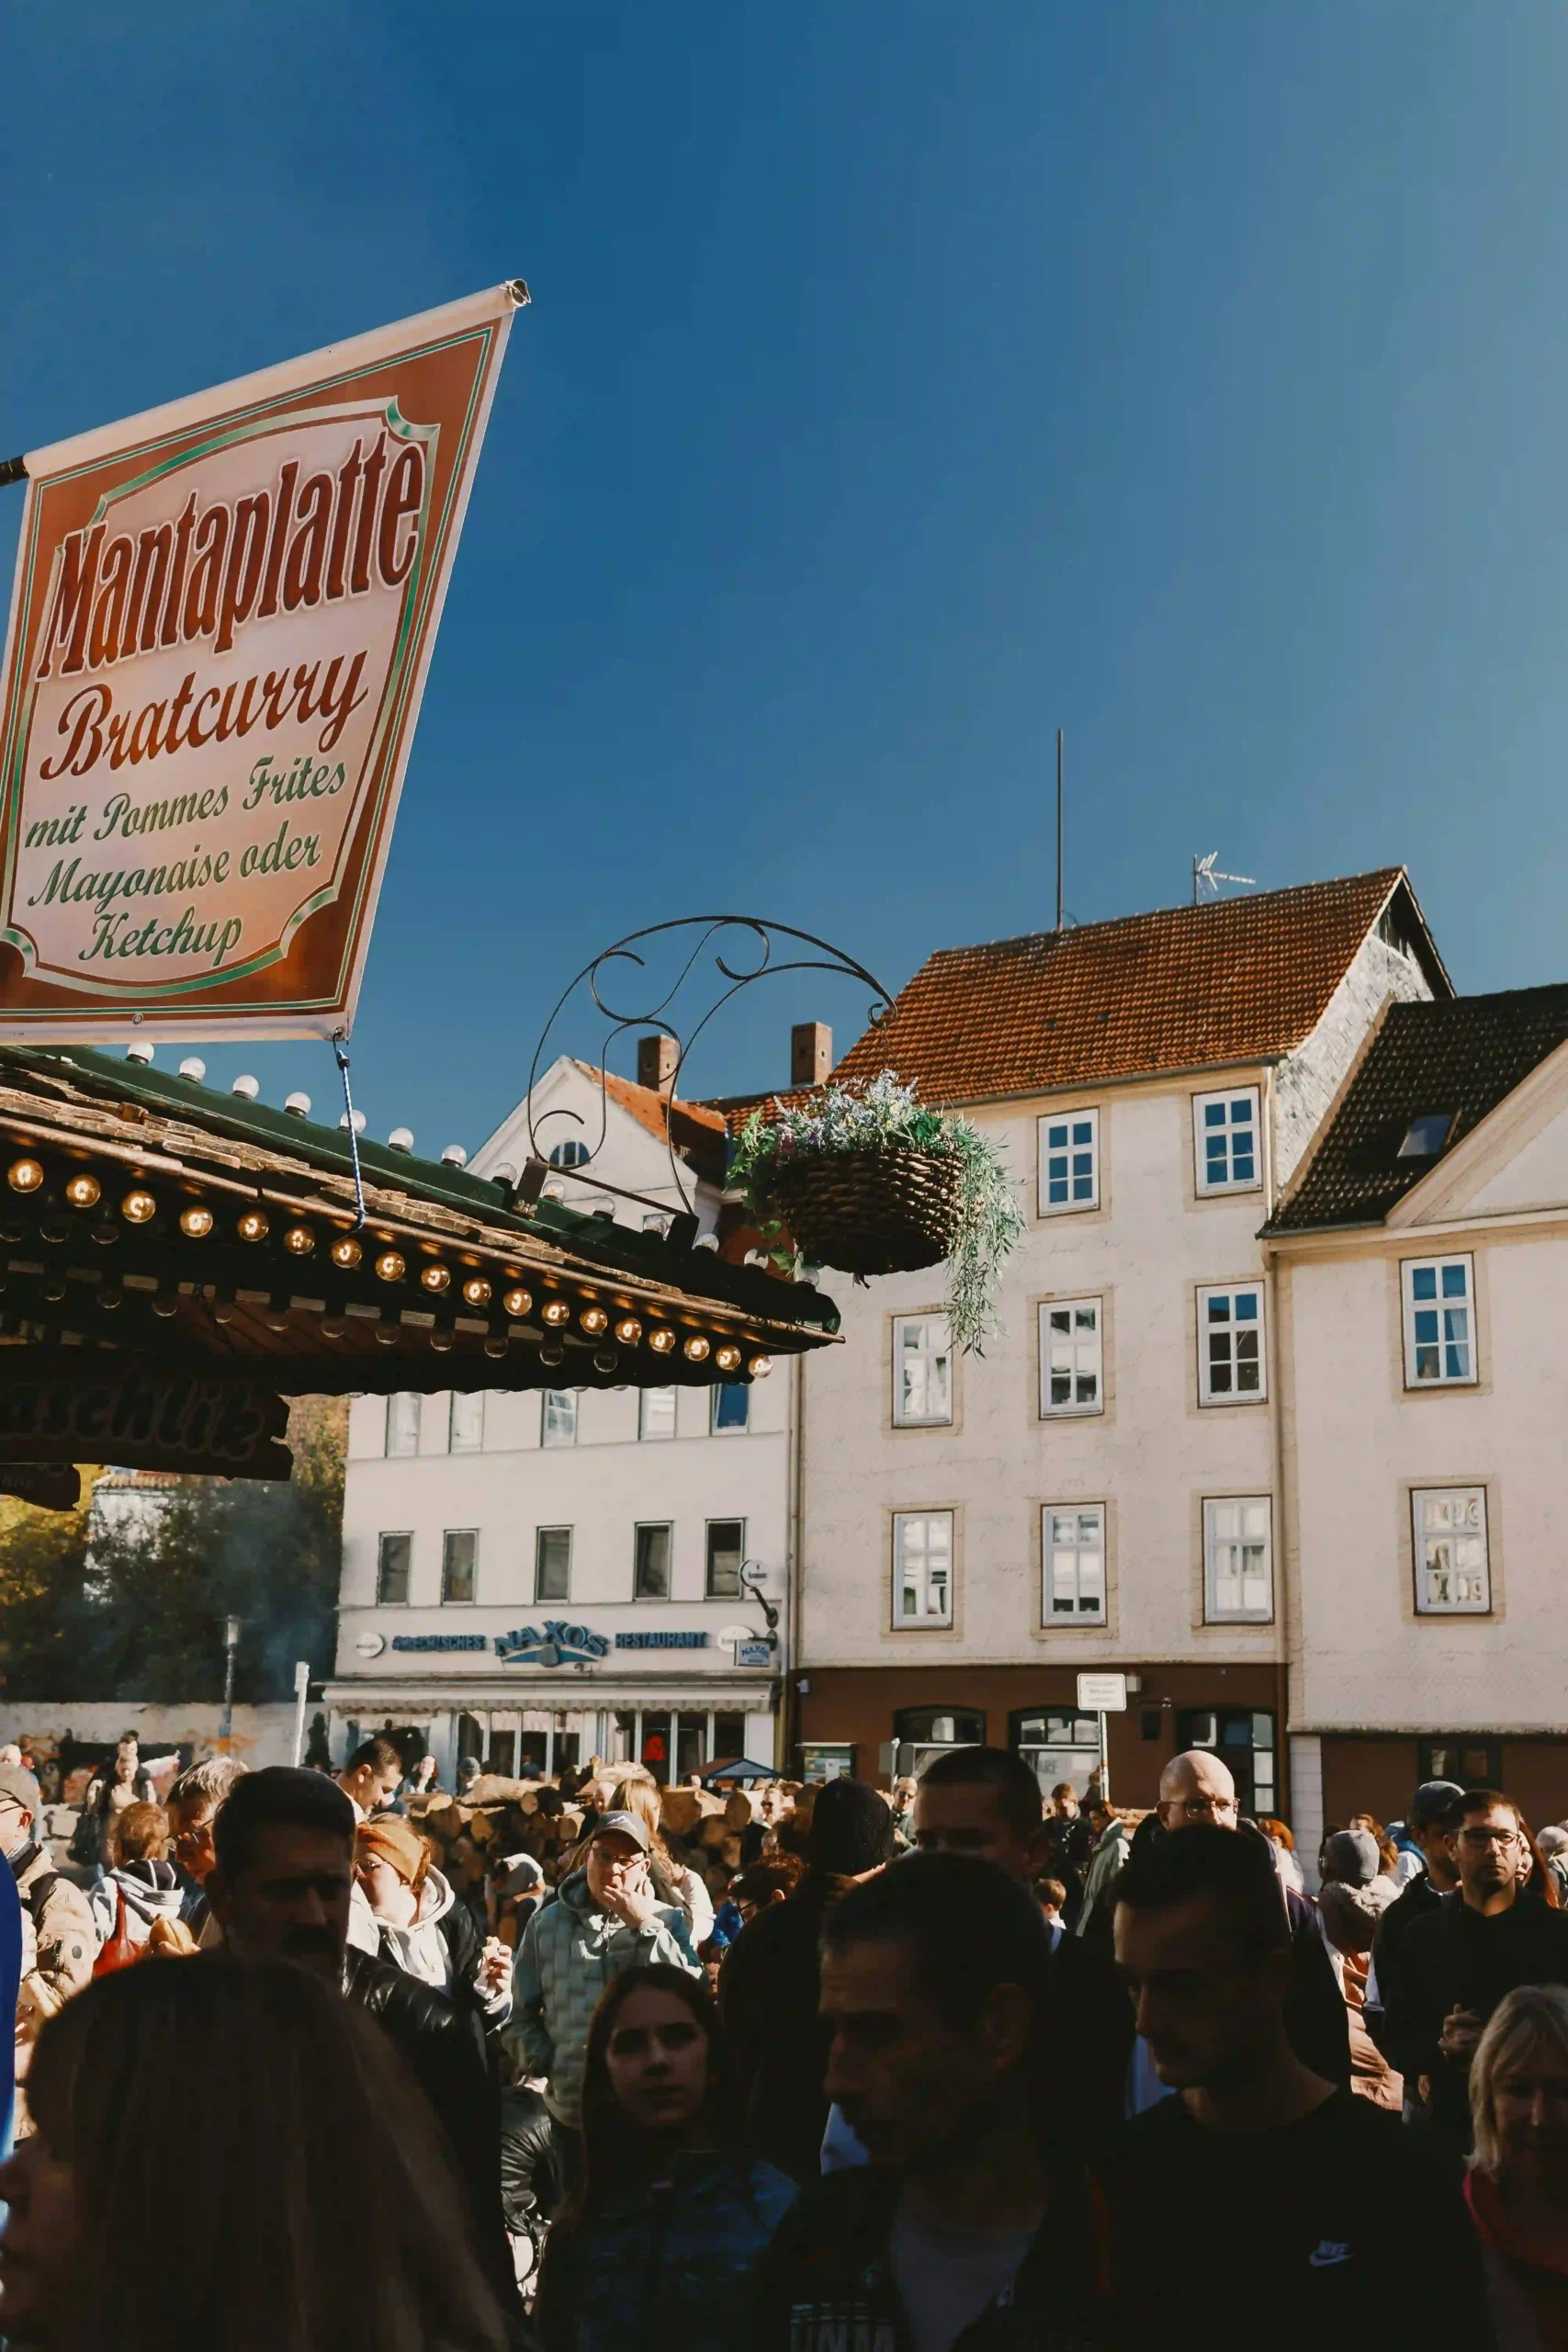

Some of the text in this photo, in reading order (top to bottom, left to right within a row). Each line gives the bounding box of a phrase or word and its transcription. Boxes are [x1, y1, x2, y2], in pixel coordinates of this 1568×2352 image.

[37, 430, 424, 679] Mantaplatte
[39, 649, 368, 781] Bratcurry
[26, 755, 346, 849] mit Pommes Frites
[28, 820, 321, 914] Mayonaise oder
[79, 907, 243, 967] Ketchup
[494, 1620, 608, 1657] NAXOS
[615, 1632, 707, 1648] RESTAURANT
